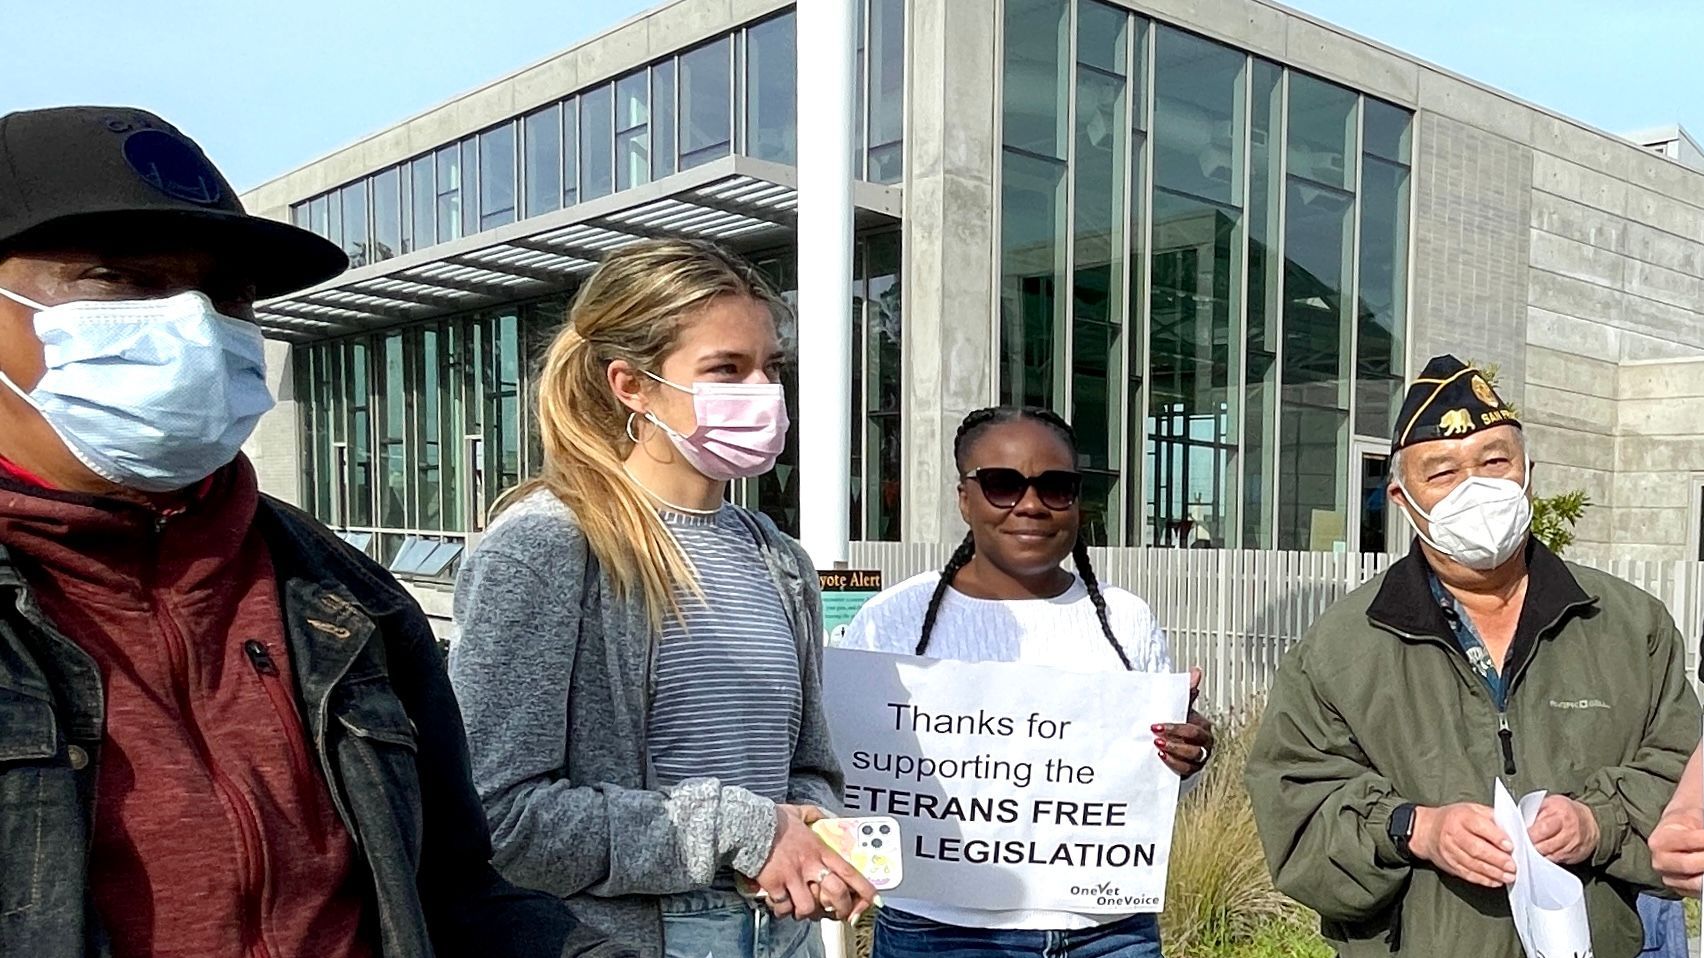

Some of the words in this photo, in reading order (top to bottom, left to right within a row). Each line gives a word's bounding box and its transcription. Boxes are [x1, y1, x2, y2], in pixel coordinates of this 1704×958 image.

[820, 574, 847, 590] yote
[850, 571, 880, 587] Alert
[888, 703, 1014, 737] Thanks
[1027, 713, 1071, 739] for
[852, 750, 1032, 788] supporting
[1046, 759, 1095, 784] the
[844, 784, 1018, 824] ETERANS
[1032, 801, 1127, 827] FREE
[915, 835, 1155, 868] LEGISLATION
[1071, 881, 1120, 896] OneVet
[1097, 893, 1160, 905] OneVoice
